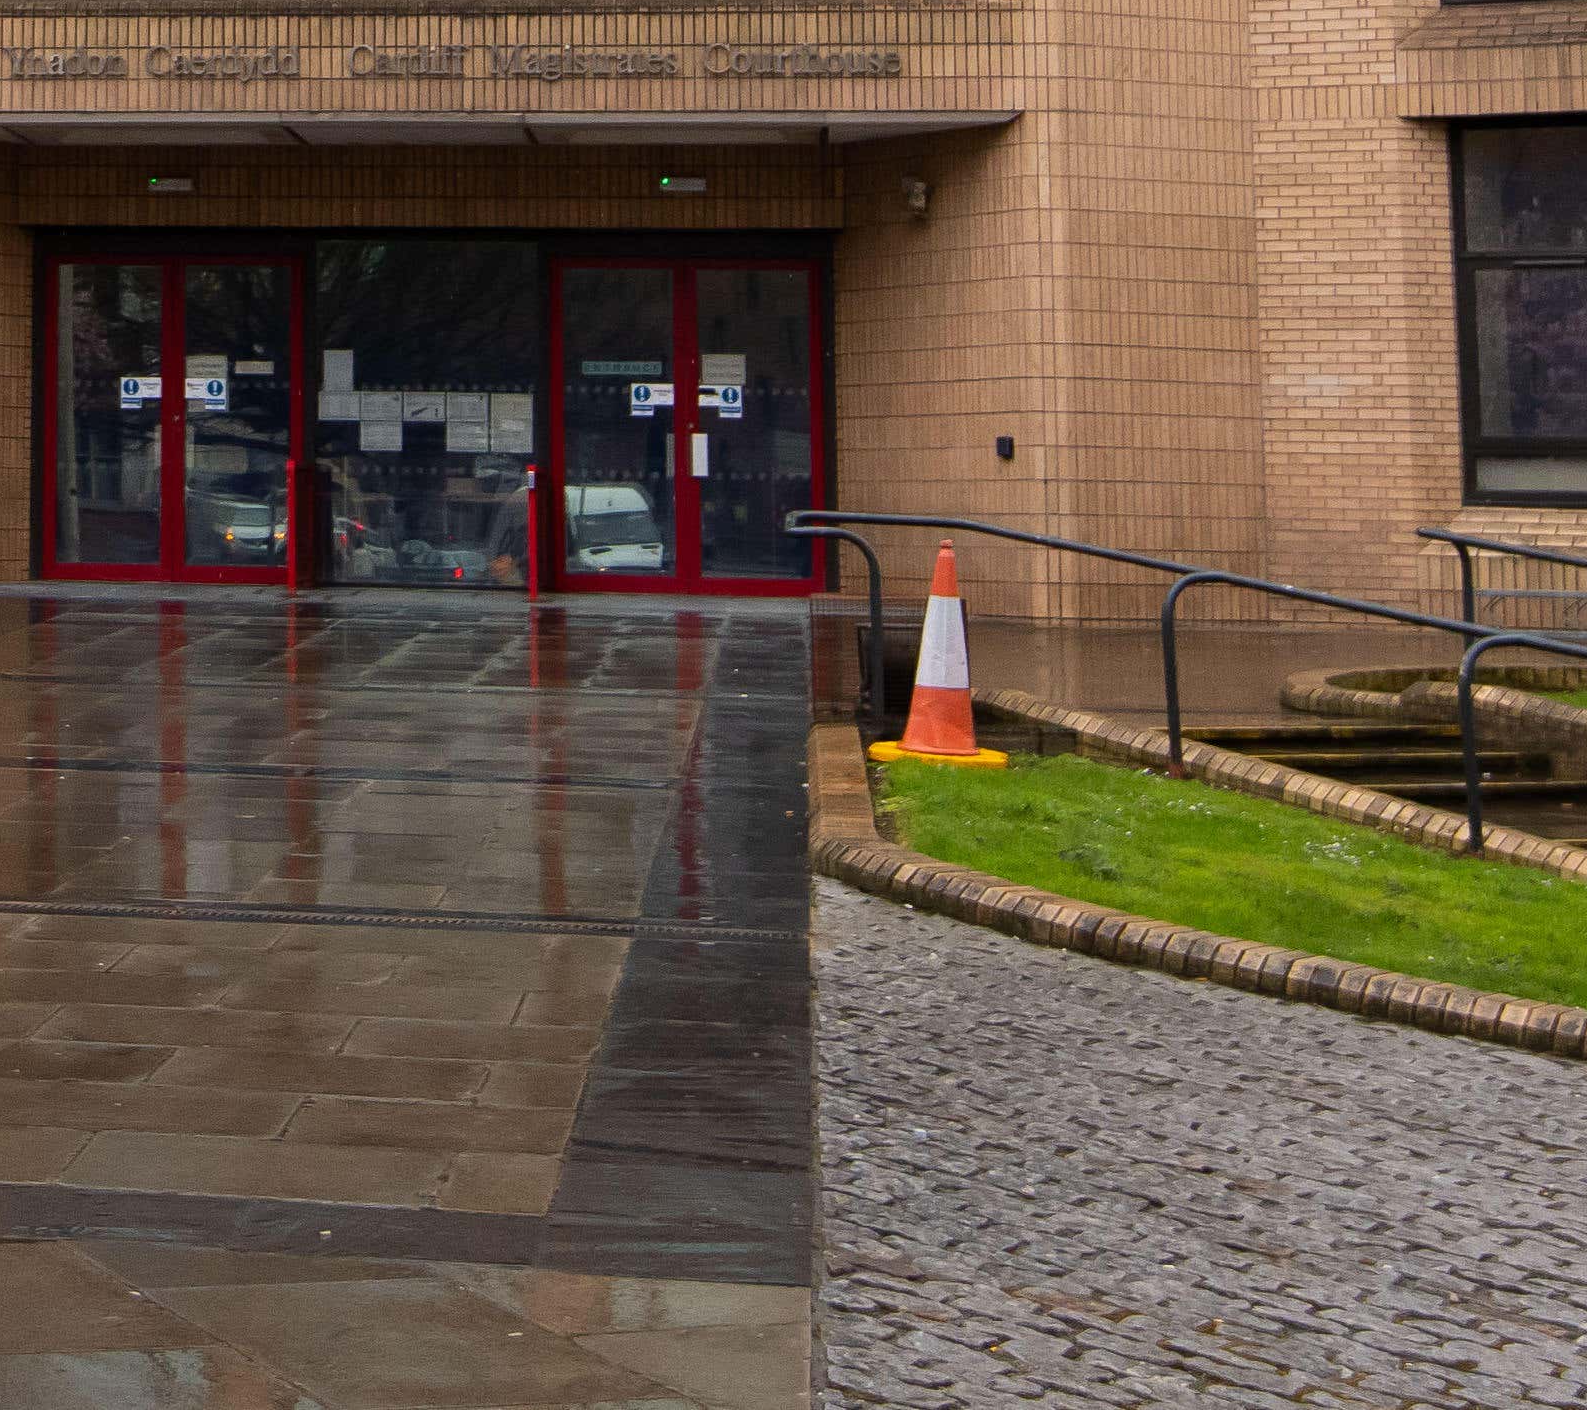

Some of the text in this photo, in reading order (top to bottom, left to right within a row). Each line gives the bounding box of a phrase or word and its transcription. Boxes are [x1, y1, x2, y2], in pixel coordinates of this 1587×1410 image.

[3, 44, 127, 79] Ynadon
[145, 44, 301, 84] Caerdydd
[349, 44, 470, 79] Cardiff
[489, 43, 679, 82] Magistrates
[704, 42, 902, 77] Courthouse
